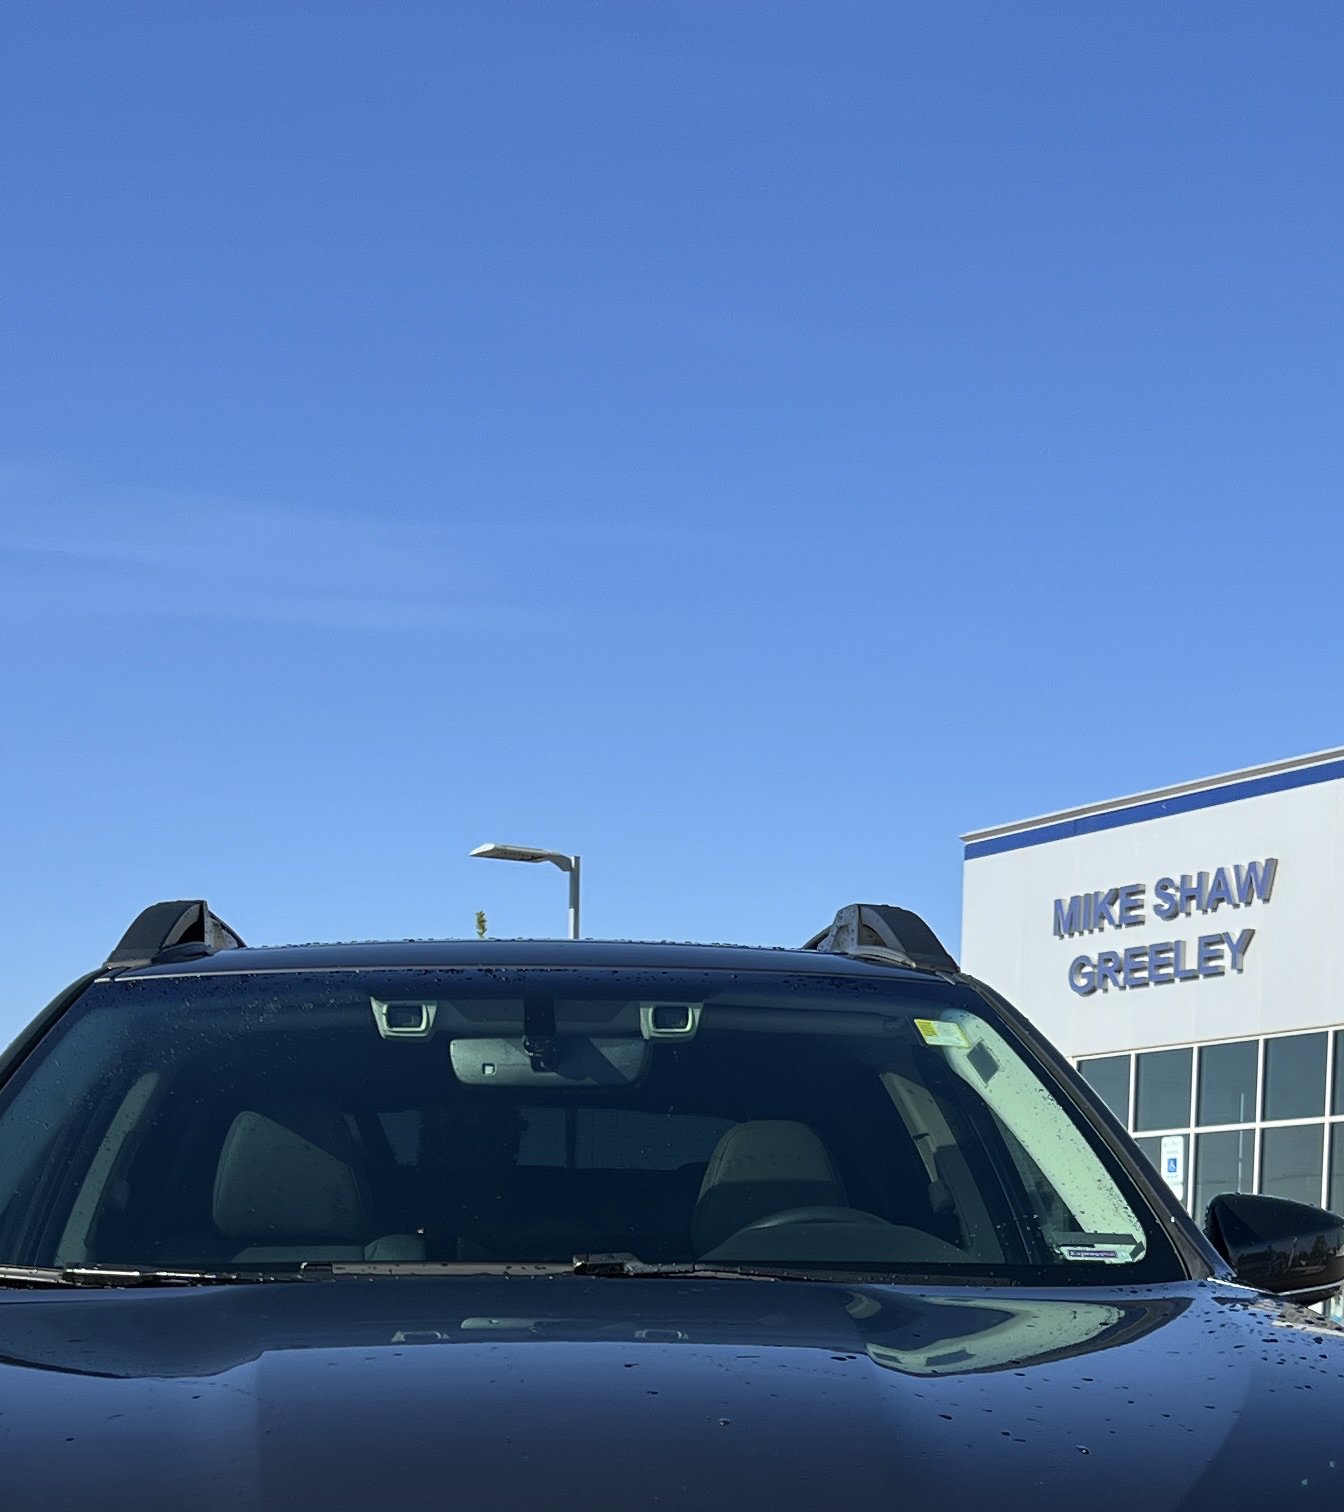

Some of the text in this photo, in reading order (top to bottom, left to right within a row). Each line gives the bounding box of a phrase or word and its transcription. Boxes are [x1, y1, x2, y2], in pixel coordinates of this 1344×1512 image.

[1053, 858, 1279, 940] MIKE SHAW
[1068, 928, 1256, 998] GREELEY
